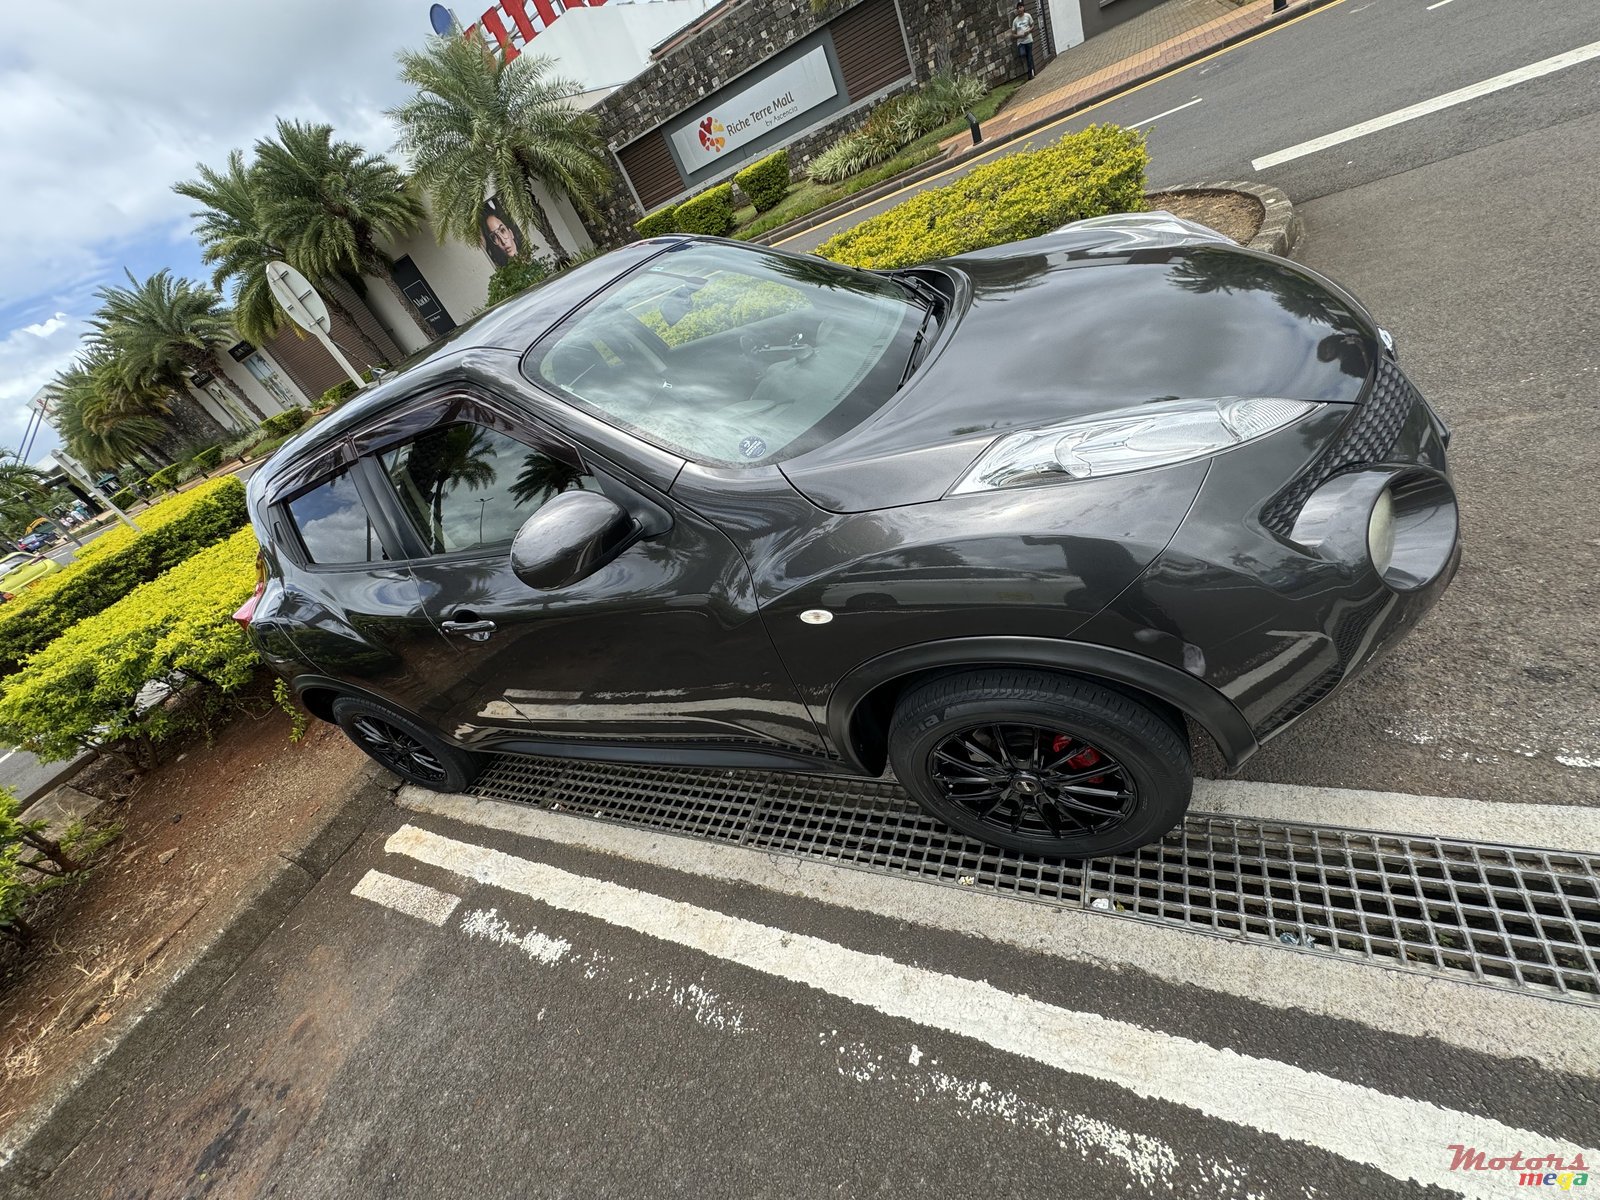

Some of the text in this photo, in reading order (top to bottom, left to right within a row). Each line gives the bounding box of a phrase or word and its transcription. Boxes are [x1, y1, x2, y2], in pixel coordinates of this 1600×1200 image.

[726, 91, 795, 136] Riche Terre Mall
[765, 105, 798, 127] by Ascencia
